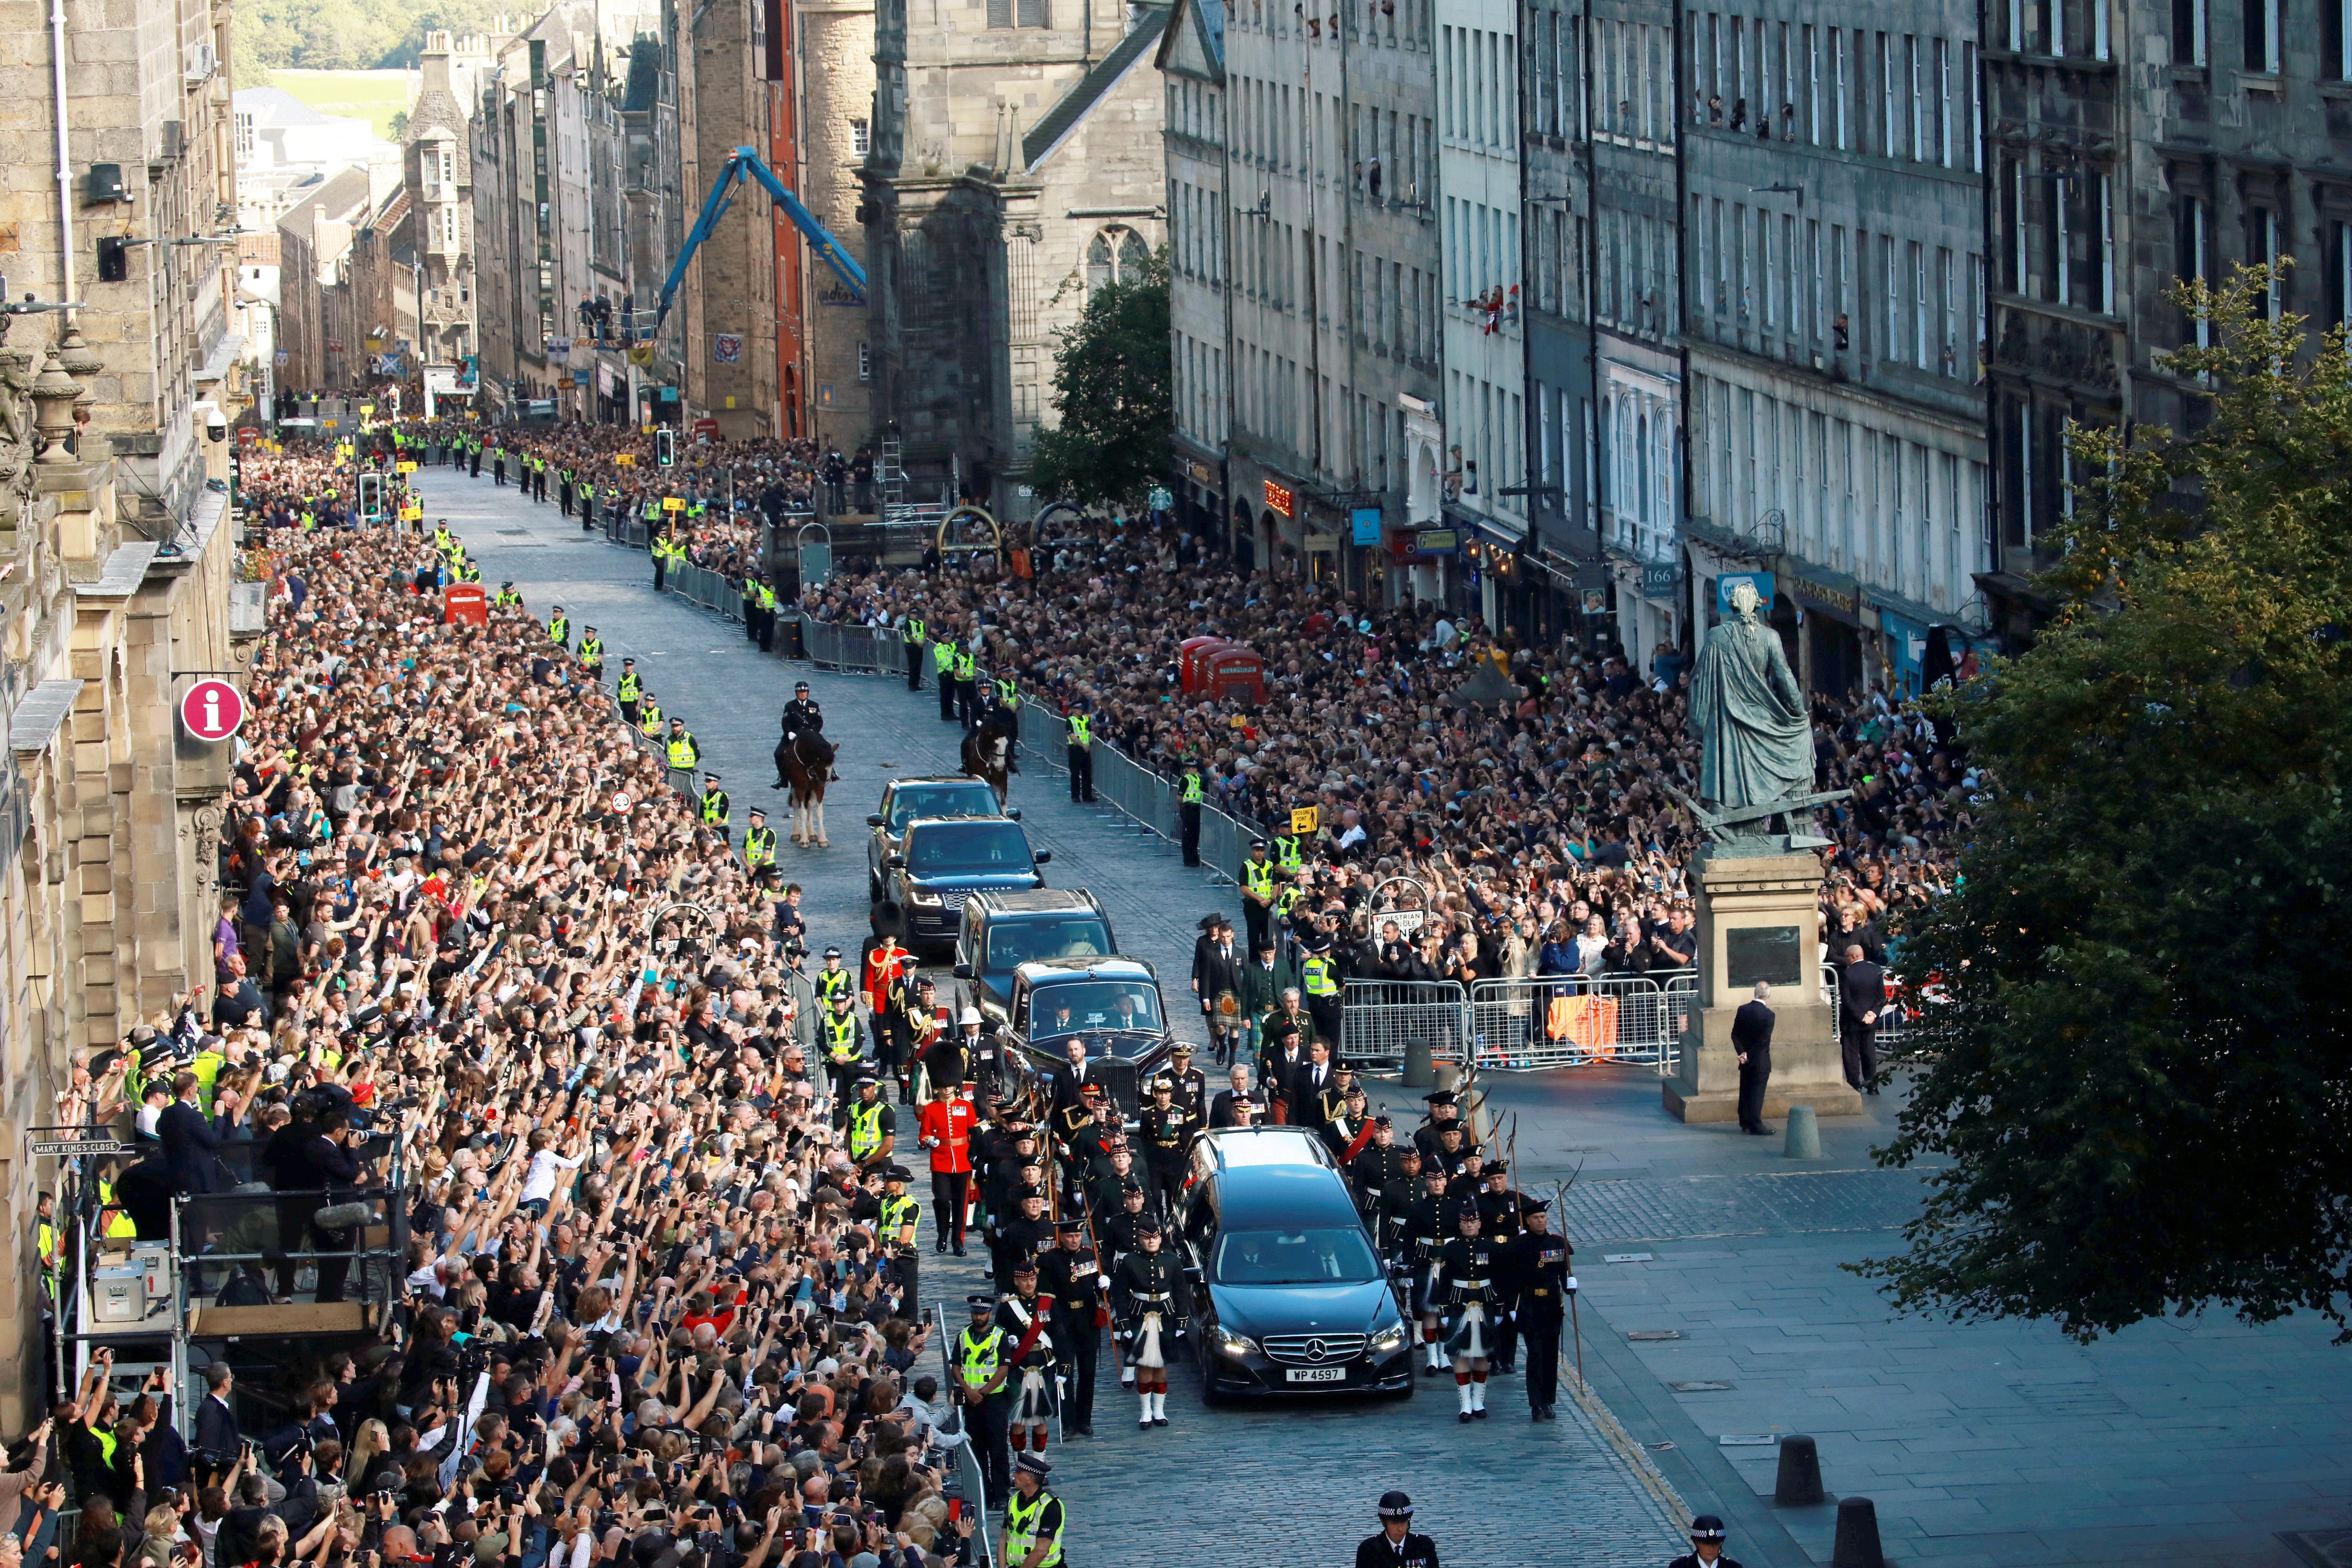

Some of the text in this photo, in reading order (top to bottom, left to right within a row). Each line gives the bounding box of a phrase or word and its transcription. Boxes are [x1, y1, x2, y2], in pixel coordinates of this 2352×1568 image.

[1648, 570, 1671, 583] 166
[1377, 913, 1420, 922] PEDESTRIAN
[36, 1145, 58, 1153] MARY
[91, 1143, 116, 1151] CLOSE
[1294, 1369, 1338, 1380] WP 4597
